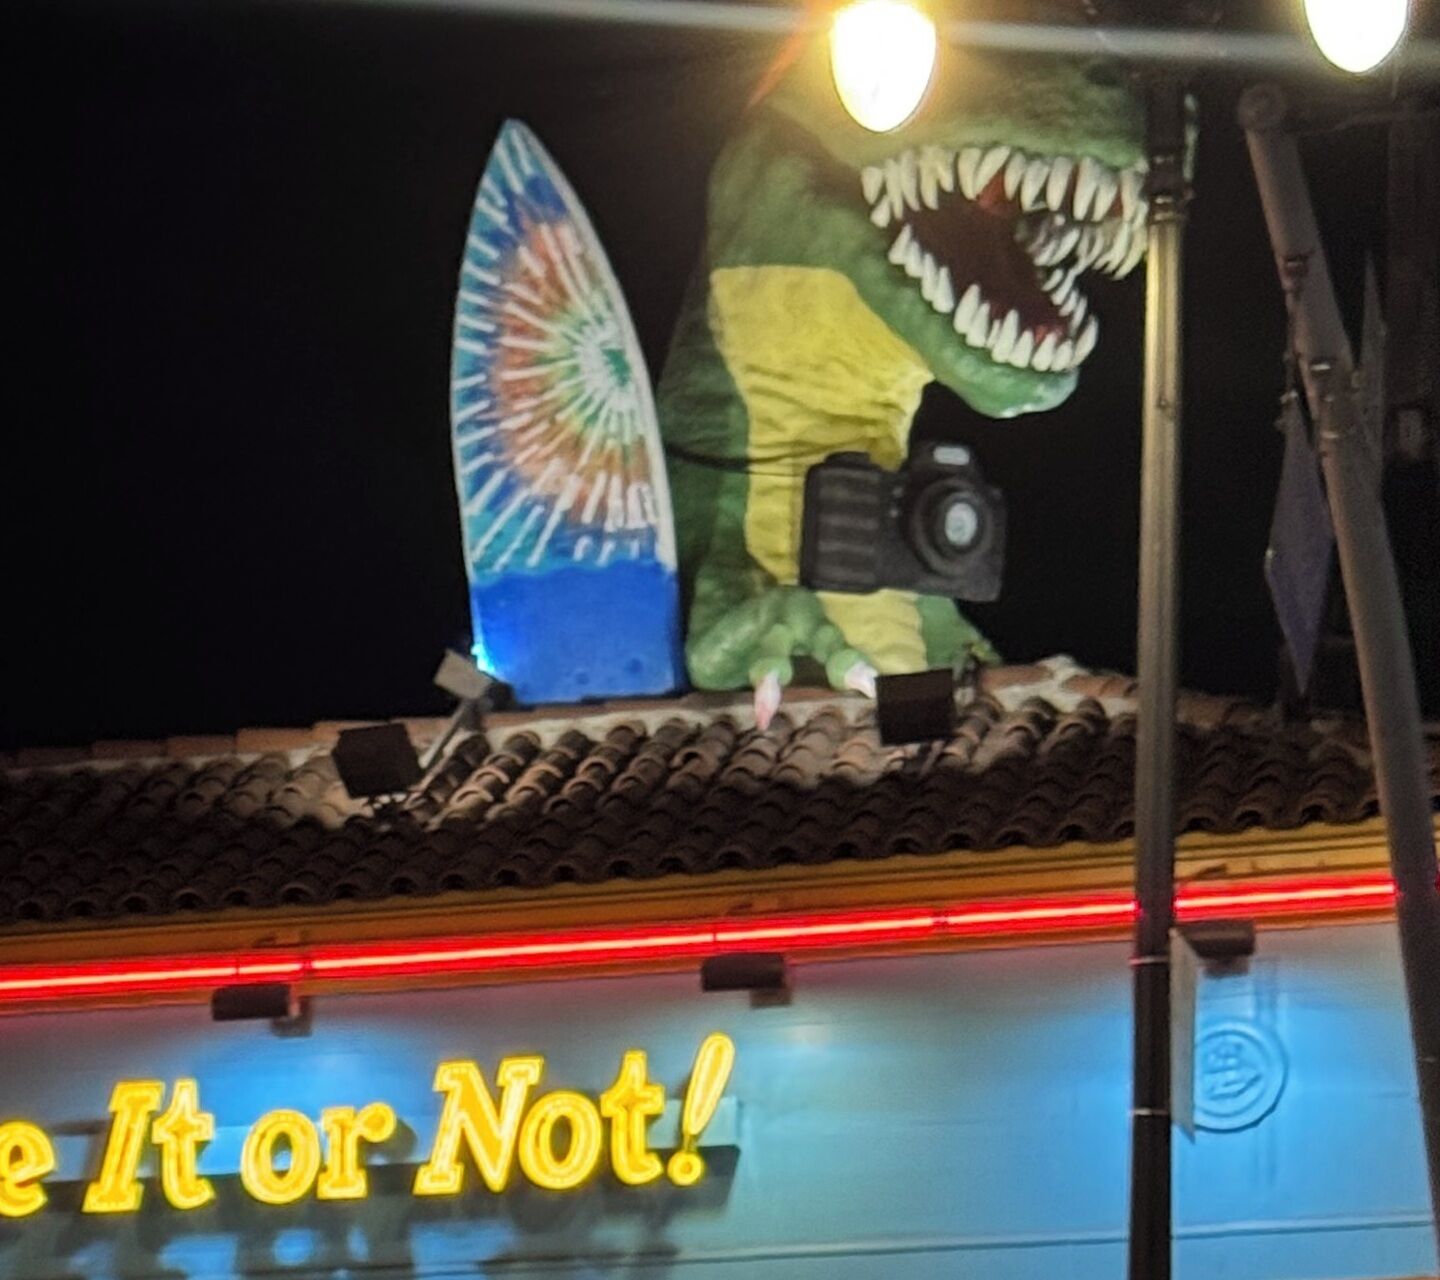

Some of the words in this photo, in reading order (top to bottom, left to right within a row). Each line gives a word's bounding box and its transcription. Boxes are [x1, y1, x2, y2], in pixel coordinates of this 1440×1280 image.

[81, 1078, 215, 1215] It
[240, 1104, 398, 1206] or
[413, 1031, 736, 1196] Not!
